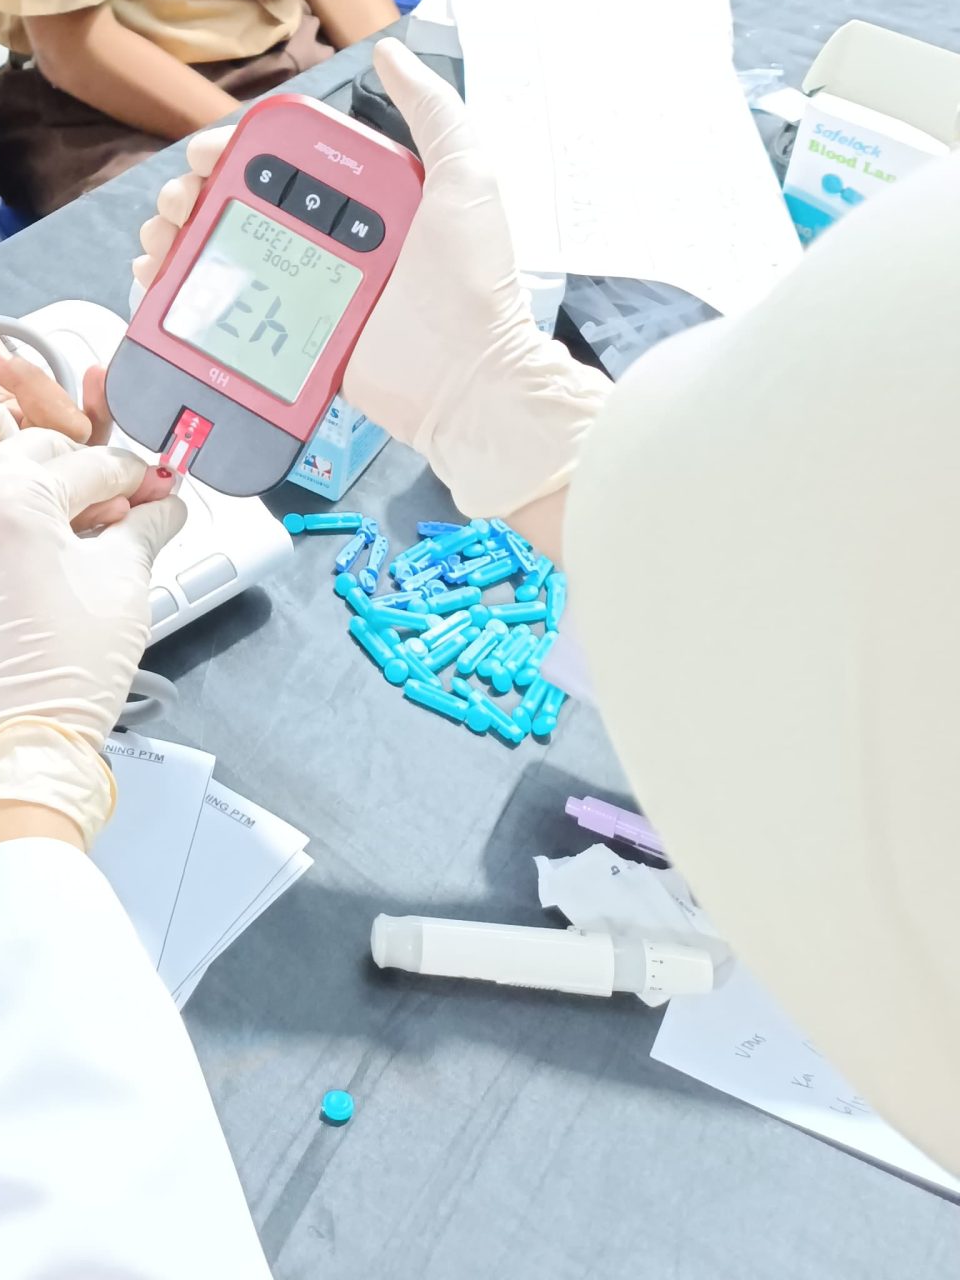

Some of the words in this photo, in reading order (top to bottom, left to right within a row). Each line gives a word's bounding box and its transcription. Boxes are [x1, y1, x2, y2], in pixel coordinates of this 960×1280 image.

[814, 122, 881, 158] Safelock
[808, 139, 857, 169] Blood
[259, 169, 273, 183] S
[351, 220, 369, 238] M
[262, 248, 300, 277] CODE
[208, 367, 230, 387] Hb
[102, 743, 136, 757] NING
[138, 750, 165, 762] PTM
[230, 809, 256, 828] PTM
